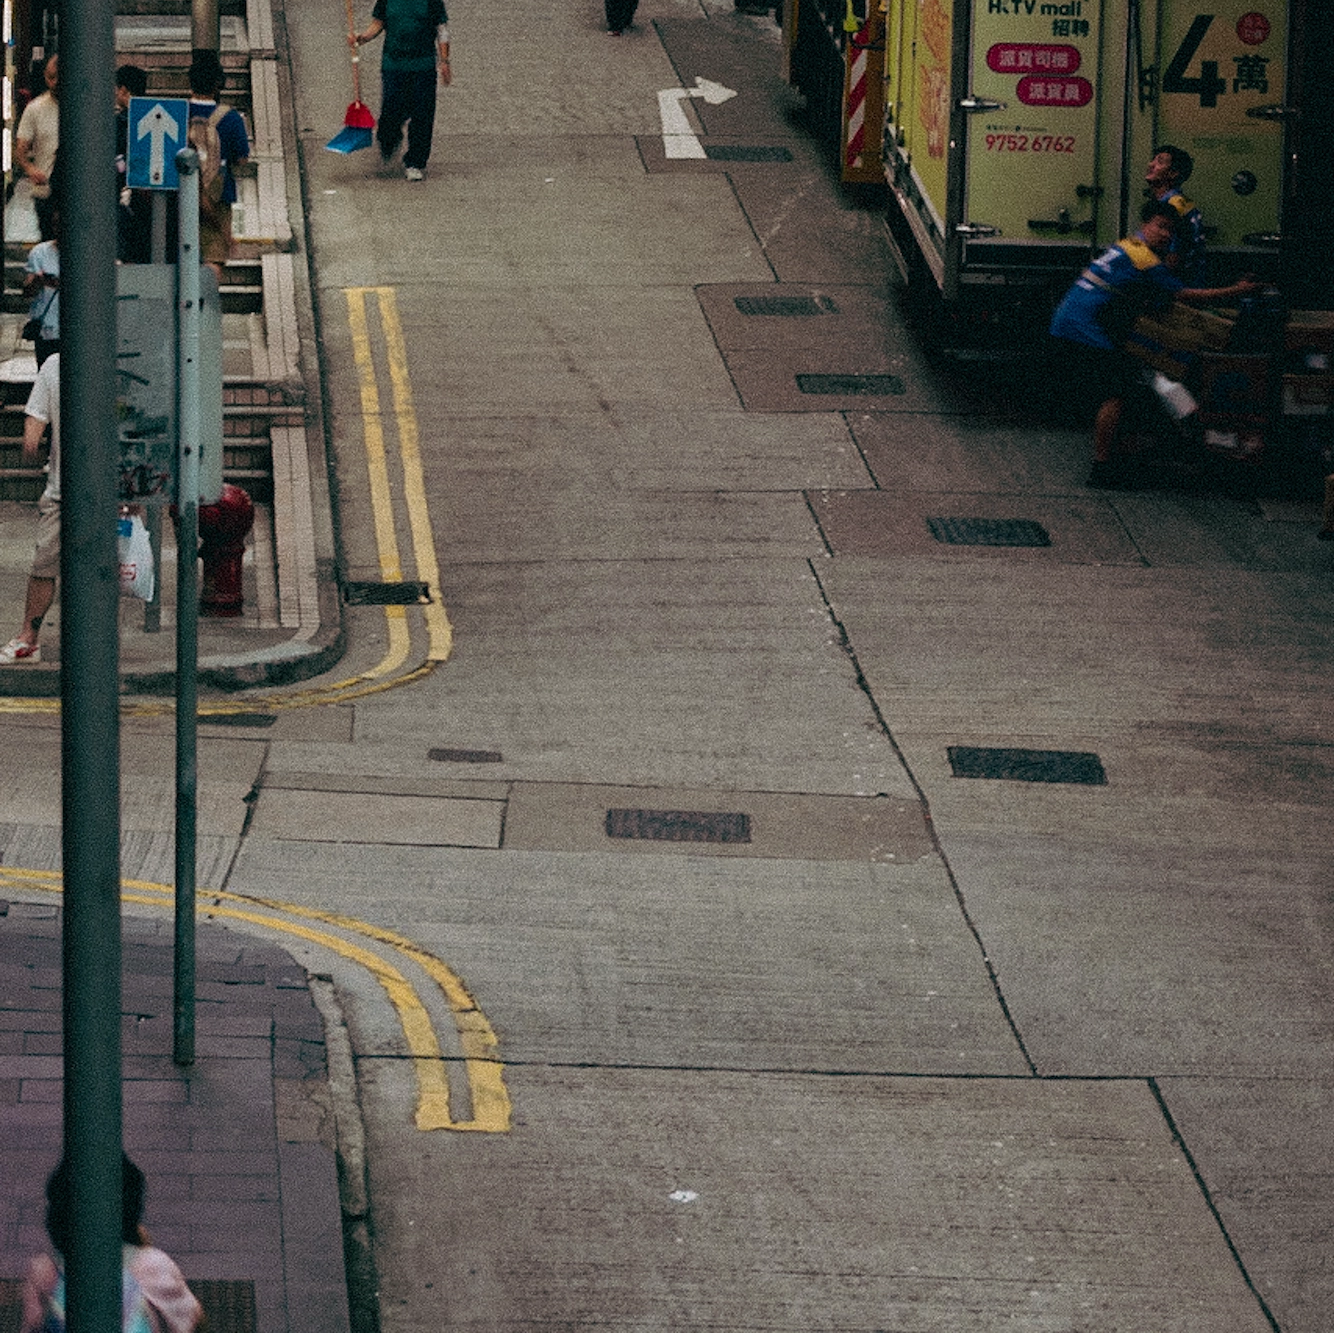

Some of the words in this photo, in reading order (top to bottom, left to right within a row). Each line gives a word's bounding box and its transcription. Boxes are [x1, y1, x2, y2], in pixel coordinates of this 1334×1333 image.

[1052, 19, 1090, 37] 招聘
[1163, 15, 1226, 107] 4
[1233, 54, 1270, 94] 萬
[985, 134, 1028, 151] 9752
[1031, 136, 1076, 153] 6762
